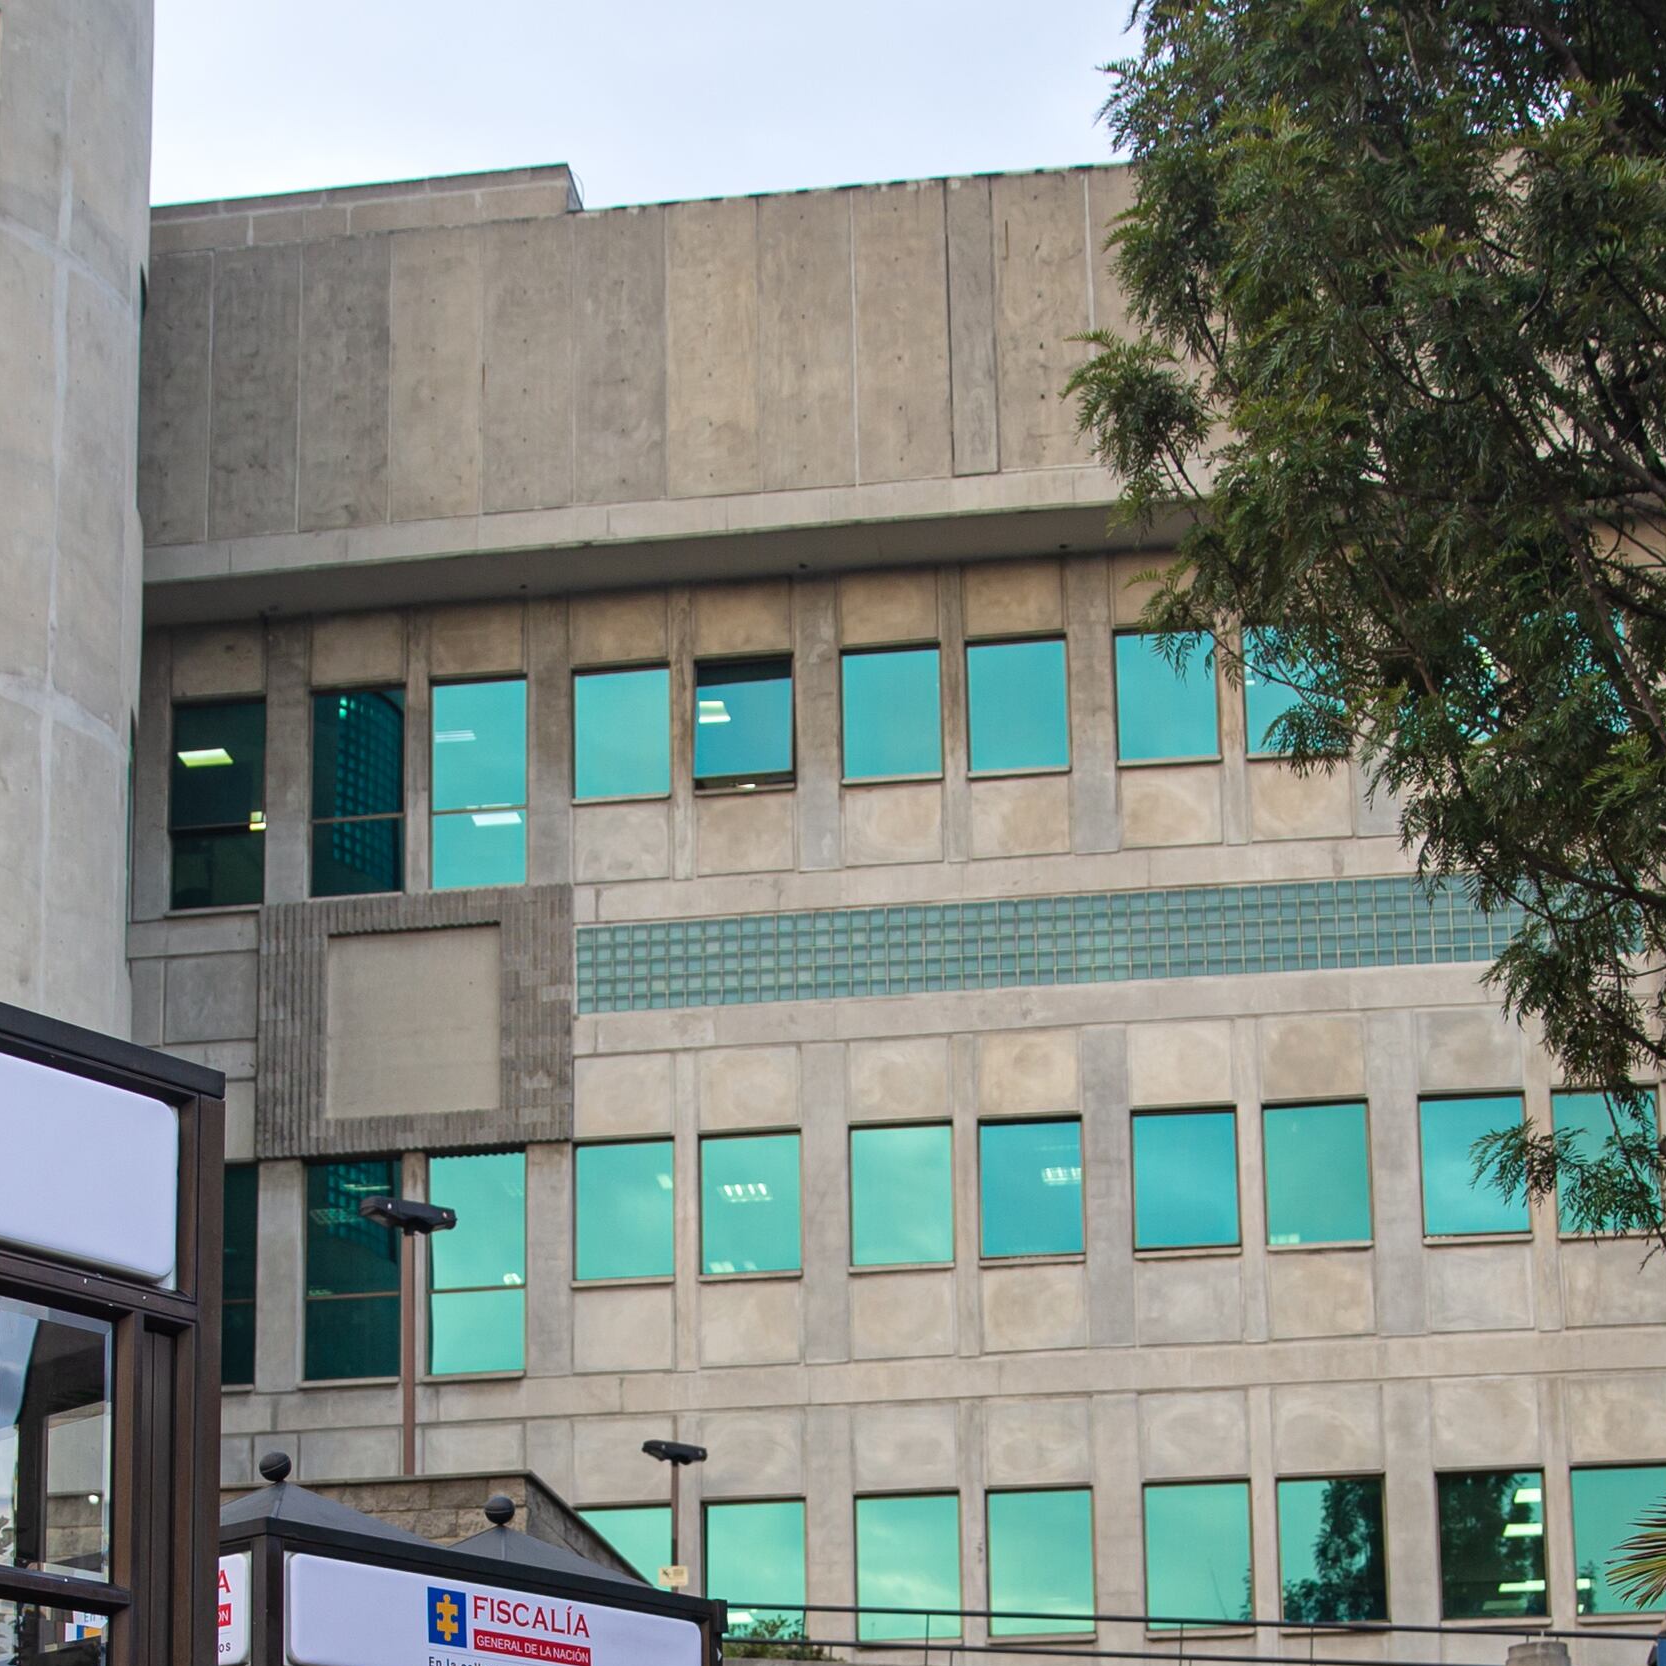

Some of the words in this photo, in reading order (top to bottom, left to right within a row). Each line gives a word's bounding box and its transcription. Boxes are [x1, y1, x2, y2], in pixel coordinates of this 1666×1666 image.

[473, 1594, 590, 1638] FISCALÍA
[476, 1635, 523, 1653] GENERAL
[524, 1642, 538, 1656] DE
[539, 1645, 552, 1658] LA
[553, 1647, 589, 1663] NACIÓN
